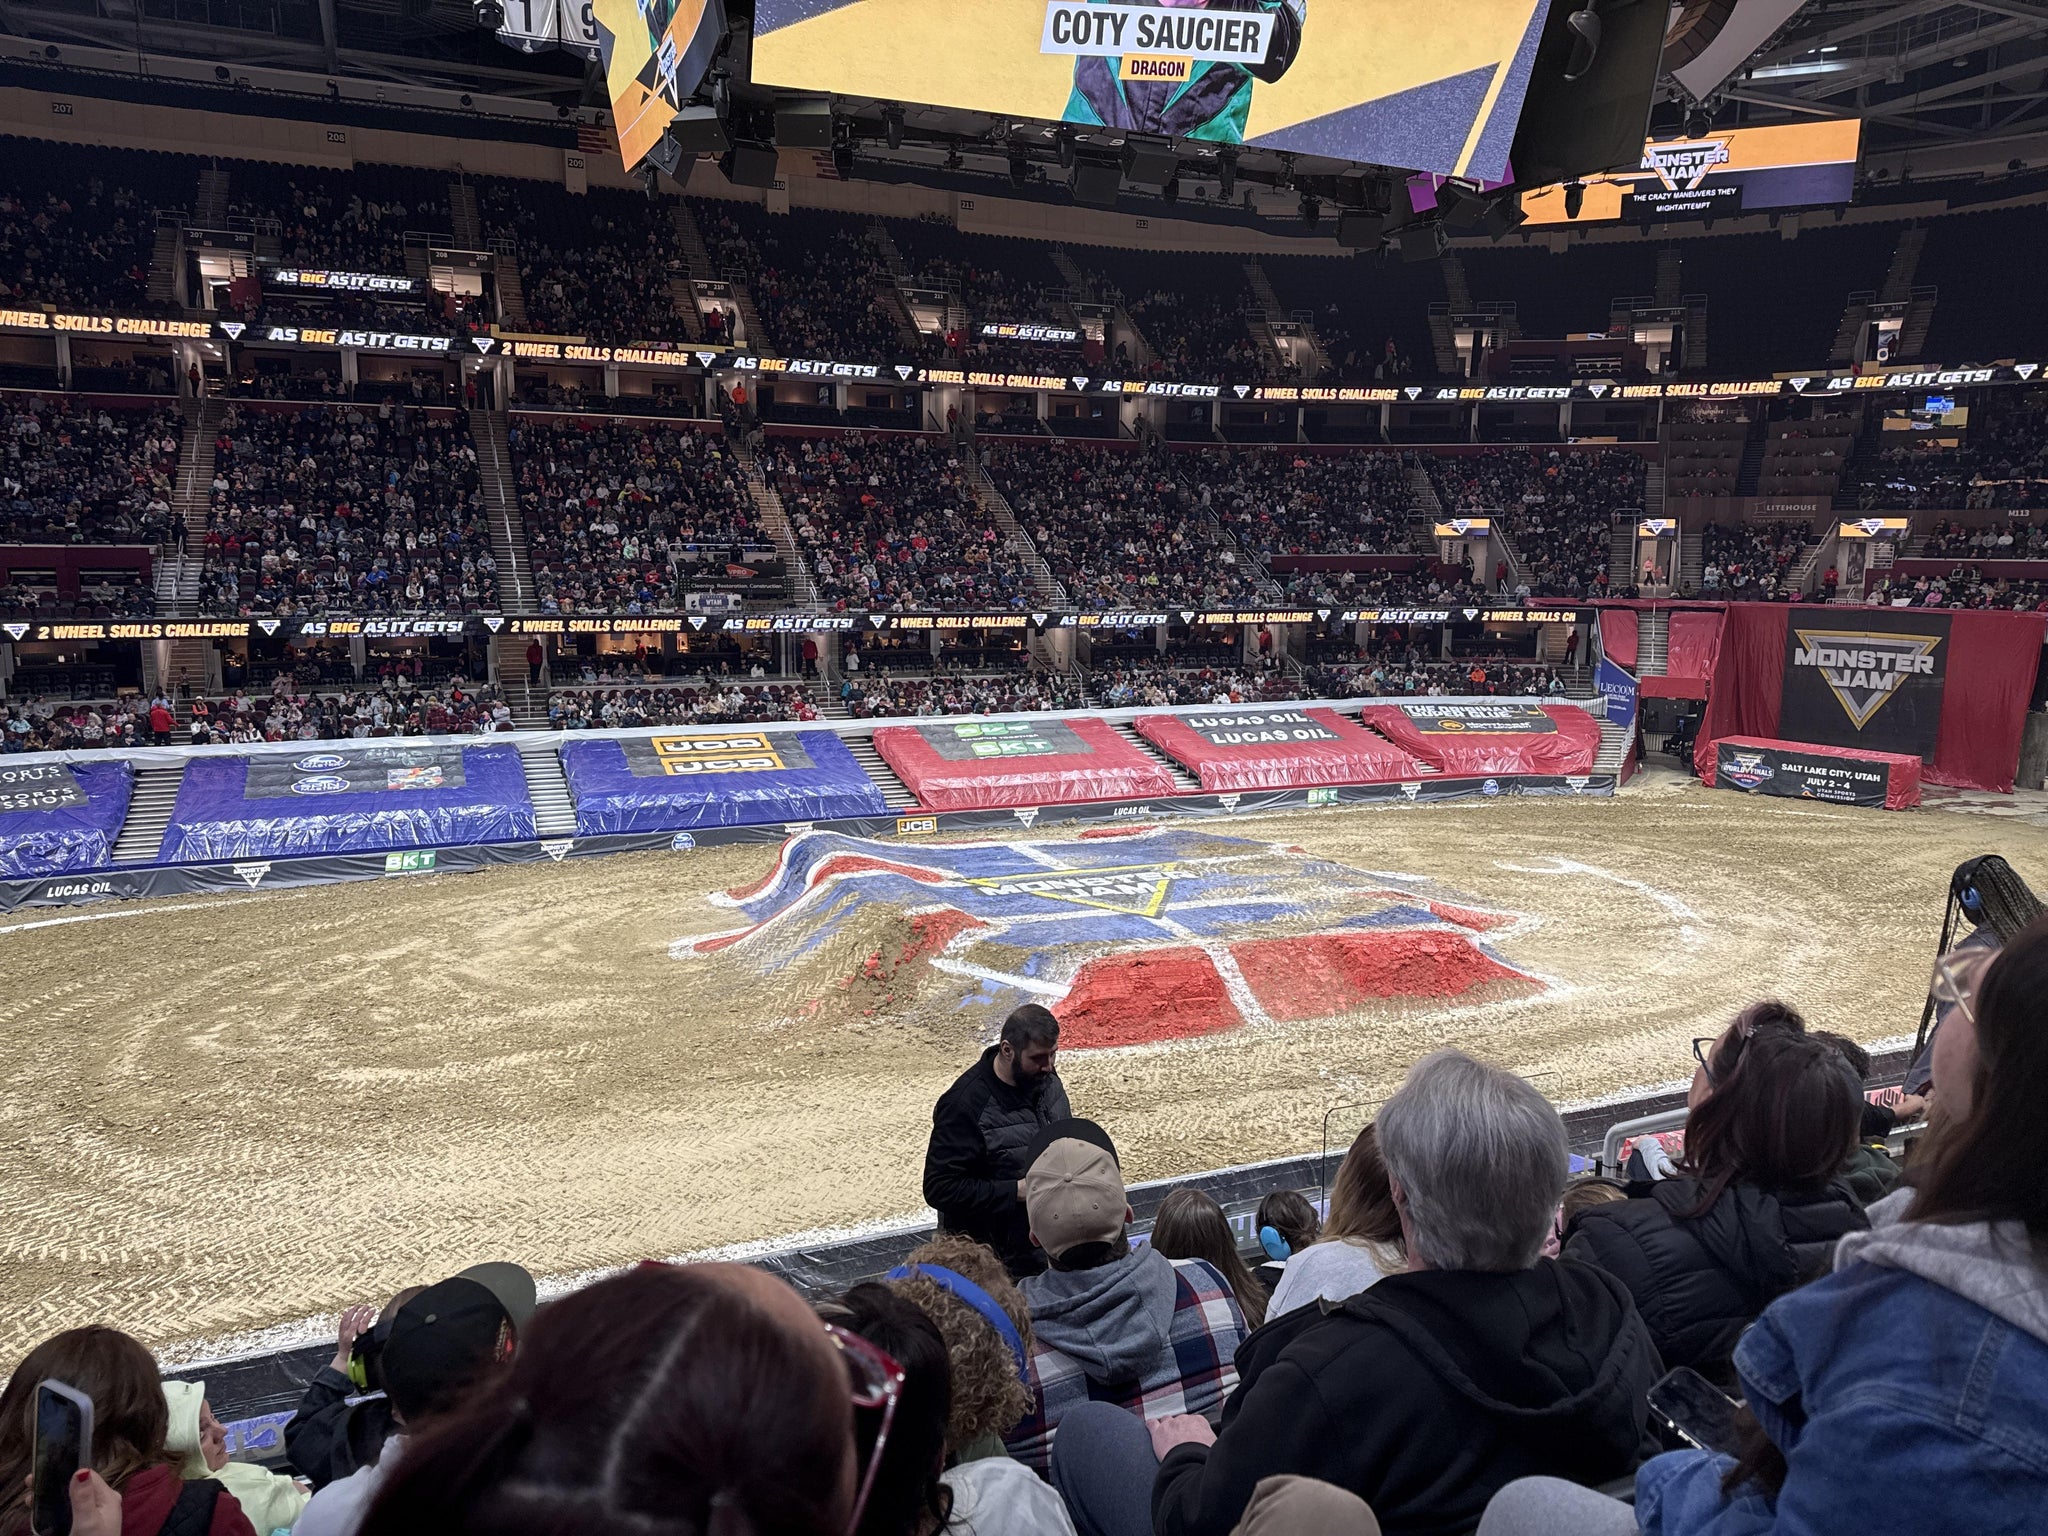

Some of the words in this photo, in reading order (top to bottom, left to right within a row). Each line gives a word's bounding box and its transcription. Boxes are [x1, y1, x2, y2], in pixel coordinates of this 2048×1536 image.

[1052, 9, 1129, 46] COTY
[1136, 13, 1262, 53] SAUCIER
[1131, 60, 1185, 76] DRAGON
[54, 104, 72, 113] 207
[328, 133, 345, 142] 208
[567, 159, 583, 168] 209
[1641, 150, 1729, 169] MONSTER
[1663, 165, 1703, 180] JAM
[1648, 193, 1672, 201] CRAZY
[1656, 202, 1711, 212] MIGHTATTEMPT
[276, 271, 298, 282] AS
[300, 272, 325, 285] BIG
[327, 275, 350, 287] AS
[350, 276, 366, 288] IT
[368, 277, 412, 291] GETS!
[53, 314, 113, 333] SKILLS
[116, 318, 212, 338] CHALLENGE
[982, 324, 998, 335] AS
[998, 325, 1016, 336] BIG
[1017, 327, 1034, 338] AS
[1033, 327, 1046, 339] IT
[1046, 328, 1076, 340] GETS!
[269, 327, 298, 342] AS
[300, 330, 336, 344] BIG
[338, 332, 367, 347] AS
[368, 333, 392, 348] IT
[394, 335, 450, 351] GETS!
[501, 343, 512, 356] 2
[514, 342, 562, 359] WHEEL
[564, 346, 611, 361] SKILLS
[613, 349, 688, 366] CHALLENGE
[733, 357, 757, 369] AS
[759, 358, 787, 372] BIG
[788, 361, 812, 373] AS
[812, 362, 831, 374] IT
[832, 363, 877, 378] GETS!
[917, 369, 927, 381] 2
[928, 370, 965, 384] WHEEL
[967, 372, 1005, 387] SKILLS
[1006, 374, 1067, 390] CHALLENGE
[1826, 378, 1854, 390] AS
[1854, 375, 1886, 388] BIG
[1886, 373, 1913, 387] AS
[1914, 372, 1938, 385] IT
[1937, 369, 1993, 384] GETS!
[1102, 380, 1122, 392] AS
[1122, 382, 1145, 393] BIG
[1145, 383, 1166, 395] AS
[1166, 383, 1183, 396] IT
[1182, 384, 1219, 397] GETS!
[1253, 388, 1263, 399] 2
[1263, 388, 1299, 400] WHEEL
[1300, 388, 1337, 400] SKILLS
[1338, 388, 1399, 401] CHALLENGE
[1436, 388, 1459, 399] AS
[1459, 387, 1485, 399] BIG
[1485, 388, 1507, 400] AS
[1507, 387, 1526, 400] IT
[1526, 387, 1571, 399] GETS!
[1611, 386, 1621, 399] 2
[1623, 384, 1663, 398] WHEEL
[1666, 383, 1707, 397] SKILLS
[1709, 380, 1783, 396] CHALLENGE
[2008, 509, 2030, 517] M113
[889, 618, 898, 629] 2
[900, 617, 934, 629] WHEEL
[935, 616, 970, 628] SKILLS
[972, 616, 1027, 628] CHALLENGE
[1059, 615, 1077, 625] AS
[1077, 615, 1099, 625] BIG
[1099, 615, 1119, 625] AS
[1118, 615, 1133, 625] IT
[1133, 614, 1167, 625] GETS!
[1197, 614, 1205, 624] 2
[1205, 613, 1235, 624] WHEEL
[1235, 613, 1266, 624] SKILLS
[1266, 612, 1313, 623] CHALLENGE
[1341, 611, 1359, 621] AS
[1358, 611, 1380, 621] BIG
[1379, 611, 1398, 621] AS
[1398, 611, 1412, 621] IT
[1412, 611, 1449, 621] GETS!
[1481, 612, 1490, 621] 2
[1491, 612, 1524, 622] WHEEL
[1526, 612, 1561, 622] SKILLS
[37, 626, 50, 640] 2
[52, 625, 106, 639] WHEEL
[110, 624, 157, 639] SKILLS
[165, 623, 250, 638] CHALLENGE
[300, 622, 328, 634] AS
[329, 622, 361, 634] BIG
[362, 621, 390, 633] AS
[390, 621, 411, 633] IT
[412, 620, 464, 633] GETS!
[510, 621, 520, 633] 2
[522, 620, 566, 633] WHEEL
[567, 620, 611, 633] SKILLS
[612, 619, 683, 632] CHALLENGE
[722, 619, 744, 630] AS
[745, 619, 772, 629] BIG
[772, 618, 794, 629] AS
[794, 618, 812, 629] IT
[812, 618, 854, 629] GETS!
[1794, 647, 1934, 675] MONSTER
[1831, 669, 1895, 691] JAM
[1211, 729, 1289, 744] LUCAS
[1781, 763, 1803, 773] SALT
[1804, 765, 1828, 776] LAKE
[1828, 768, 1853, 780] CITY,
[1854, 771, 1881, 783] UTAH
[1806, 777, 1826, 787] JULY
[1828, 780, 1836, 788] 2
[1843, 781, 1851, 789] 4
[1307, 790, 1337, 802] BKT
[1834, 789, 1856, 797] SPORTS
[1113, 807, 1138, 816] LUCAS
[1138, 806, 1150, 815] OIL
[900, 820, 935, 833] JCB
[386, 853, 434, 869] BKT
[47, 883, 90, 898] LUCAS
[90, 881, 112, 894] OIL
[978, 871, 1200, 897] MONSTER
[1060, 881, 1161, 899] JAM
